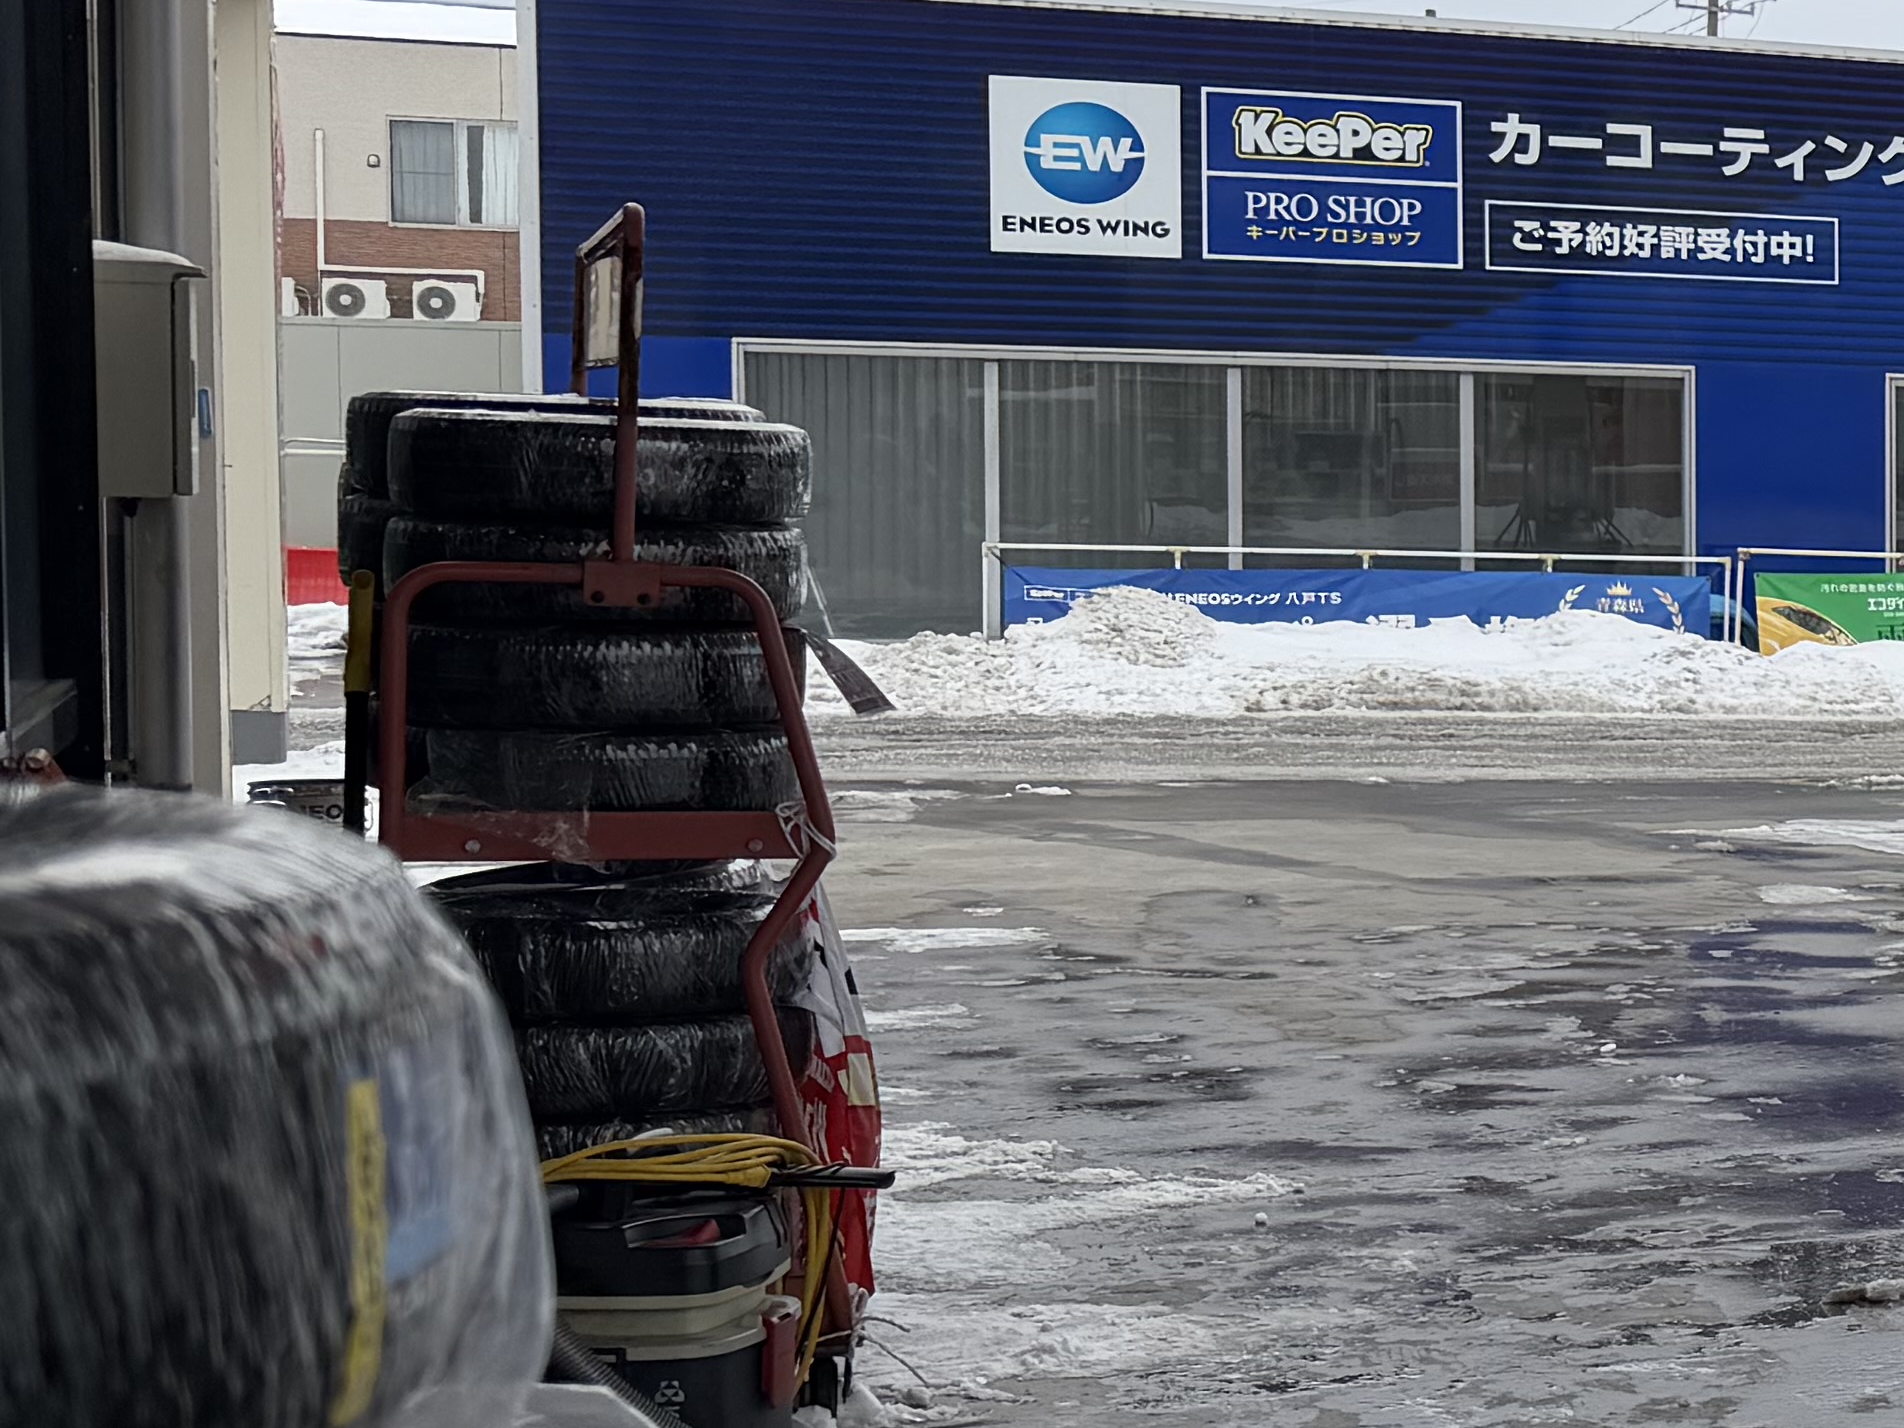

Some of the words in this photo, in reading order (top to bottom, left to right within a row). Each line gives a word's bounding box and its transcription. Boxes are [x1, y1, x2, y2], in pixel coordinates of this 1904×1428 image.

[1236, 108, 1430, 164] KeePer
[1001, 214, 1091, 236] ENEOS
[1095, 218, 1171, 240] WING
[1244, 190, 1319, 222] PRO
[1326, 194, 1423, 227] SHOP
[1246, 225, 1422, 247] キーパープロショップ
[1512, 219, 1815, 265] ご予約好評受付中!
